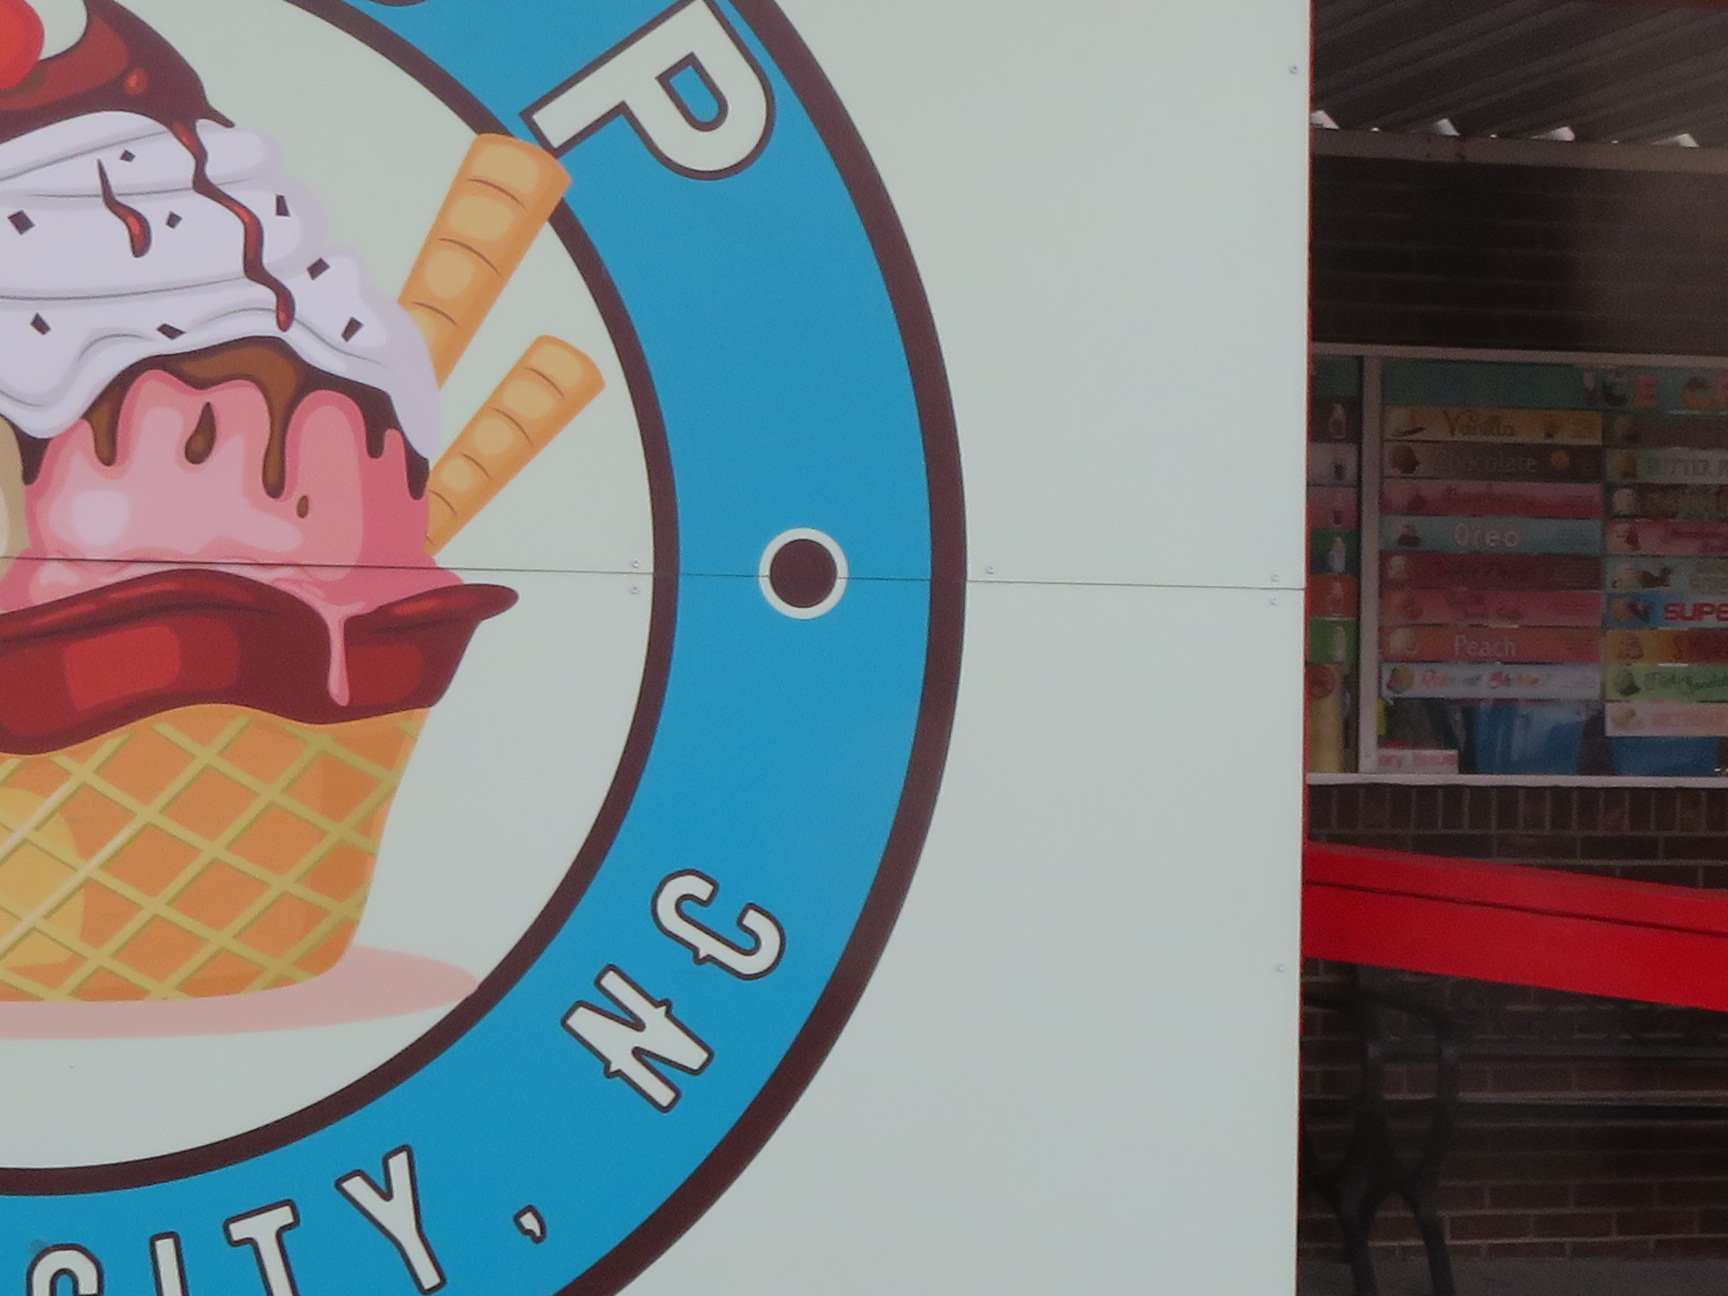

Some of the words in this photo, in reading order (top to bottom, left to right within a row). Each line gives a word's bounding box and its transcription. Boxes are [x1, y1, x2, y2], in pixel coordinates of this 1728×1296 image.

[1453, 522, 1520, 548] Oreo
[1453, 633, 1517, 658] Peach
[561, 866, 786, 1111] NC
